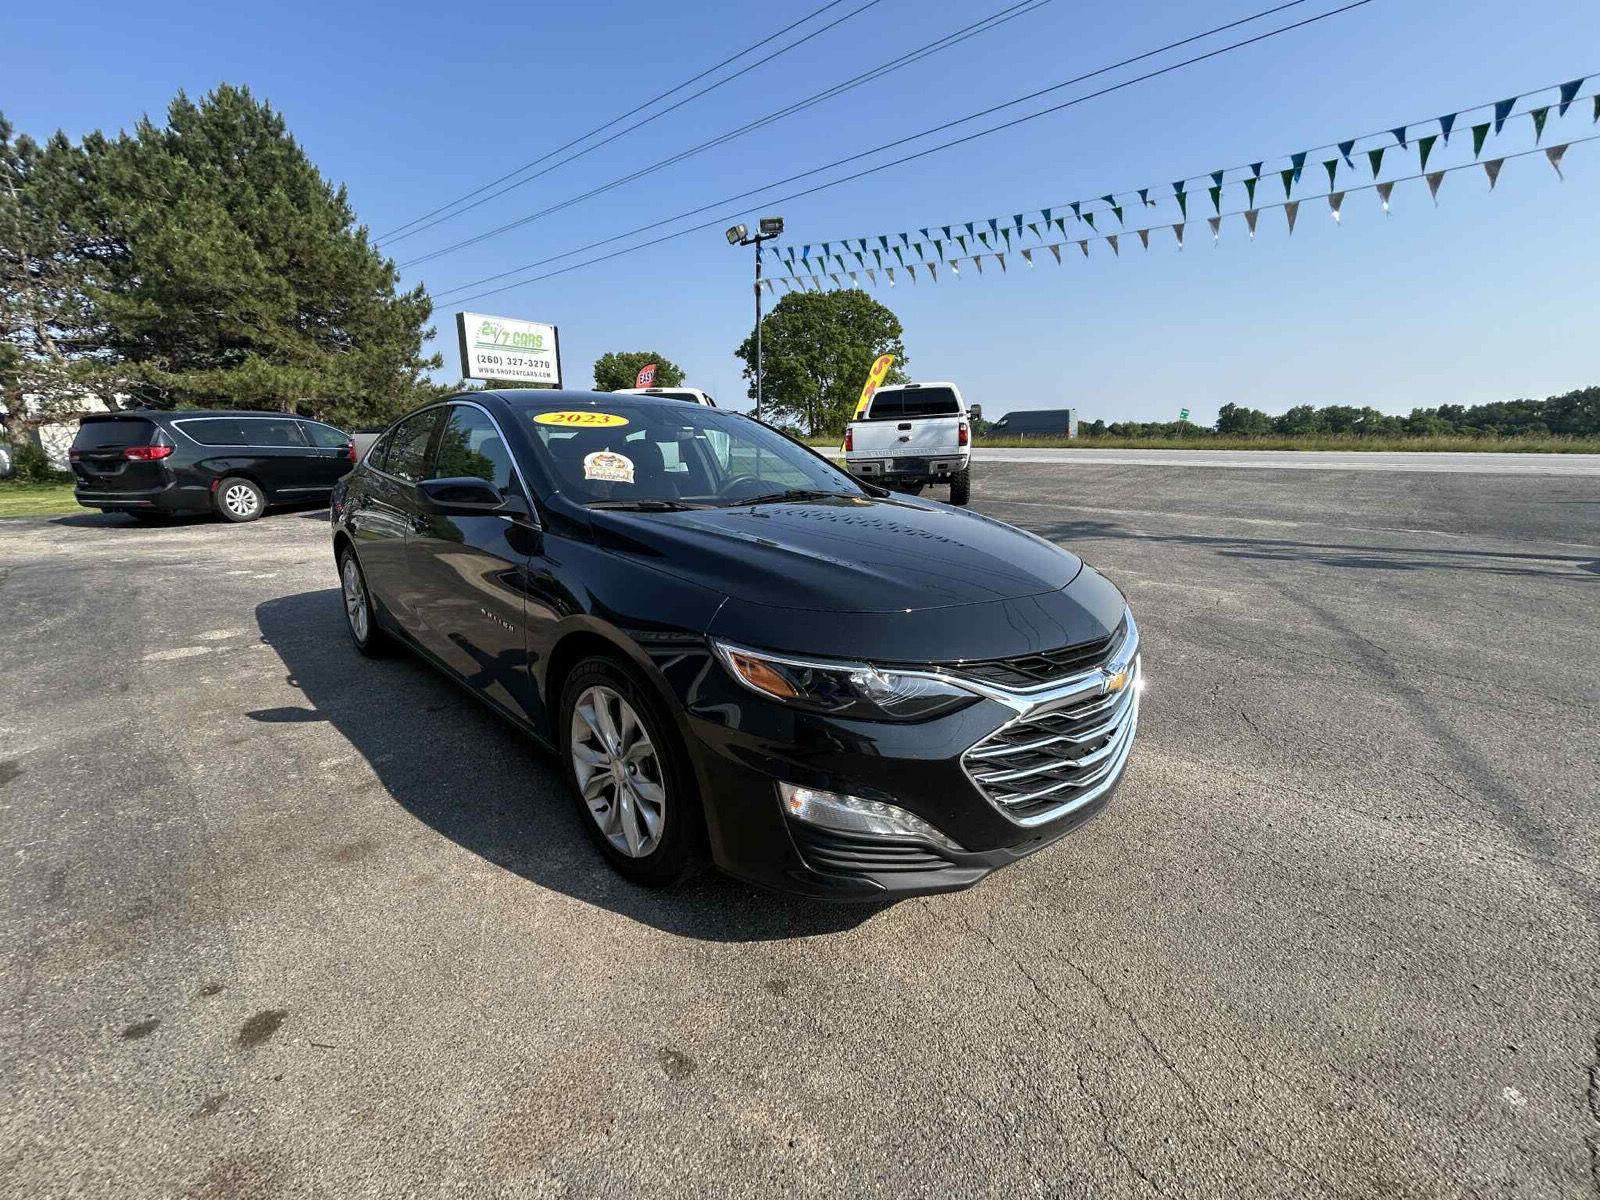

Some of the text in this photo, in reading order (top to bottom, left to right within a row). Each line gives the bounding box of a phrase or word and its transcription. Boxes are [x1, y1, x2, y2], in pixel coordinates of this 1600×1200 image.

[481, 321, 543, 347] 24/7 CARS
[477, 354, 550, 369] (260) 327-3270
[640, 369, 656, 384] EASY
[550, 413, 610, 424] 2023
